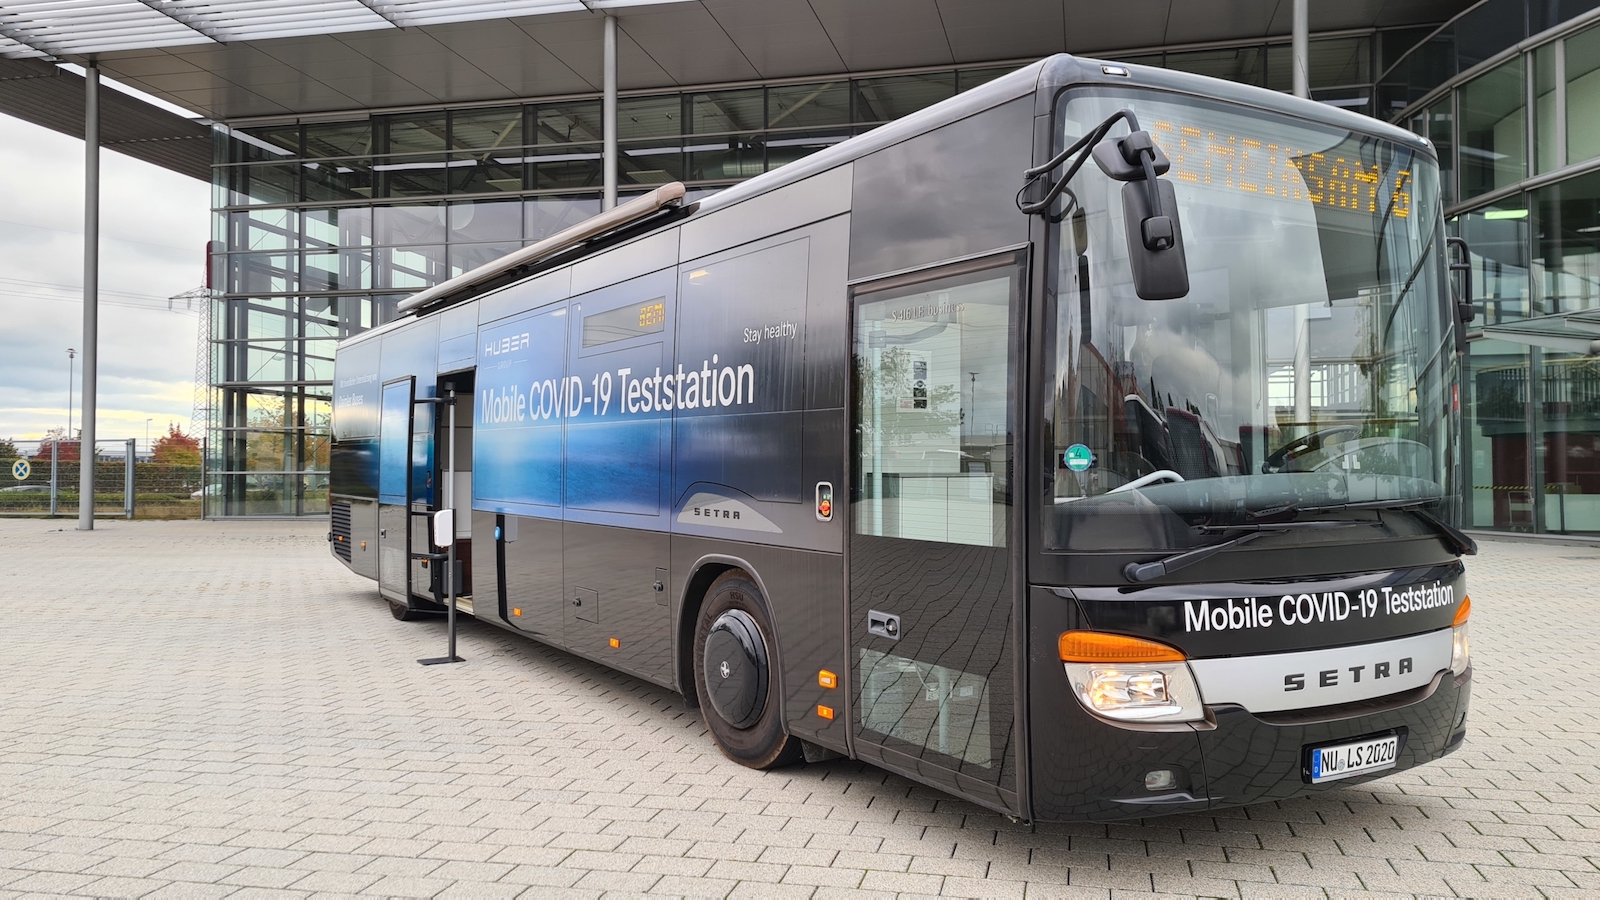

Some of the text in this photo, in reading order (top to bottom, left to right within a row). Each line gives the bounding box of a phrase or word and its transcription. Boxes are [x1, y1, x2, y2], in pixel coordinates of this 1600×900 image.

[484, 332, 529, 358] HUBER
[743, 320, 797, 345] Stay healthy
[481, 353, 754, 424] Mobile COVID-19 Teststation
[1075, 448, 1082, 458] 4
[694, 507, 741, 520] SETRA
[1184, 580, 1454, 632] Mobile COVID-19 Teststation
[1284, 657, 1413, 692] SETRA
[1321, 750, 1338, 773] NU
[1347, 746, 1363, 768] LS
[1365, 740, 1395, 765] 2020
